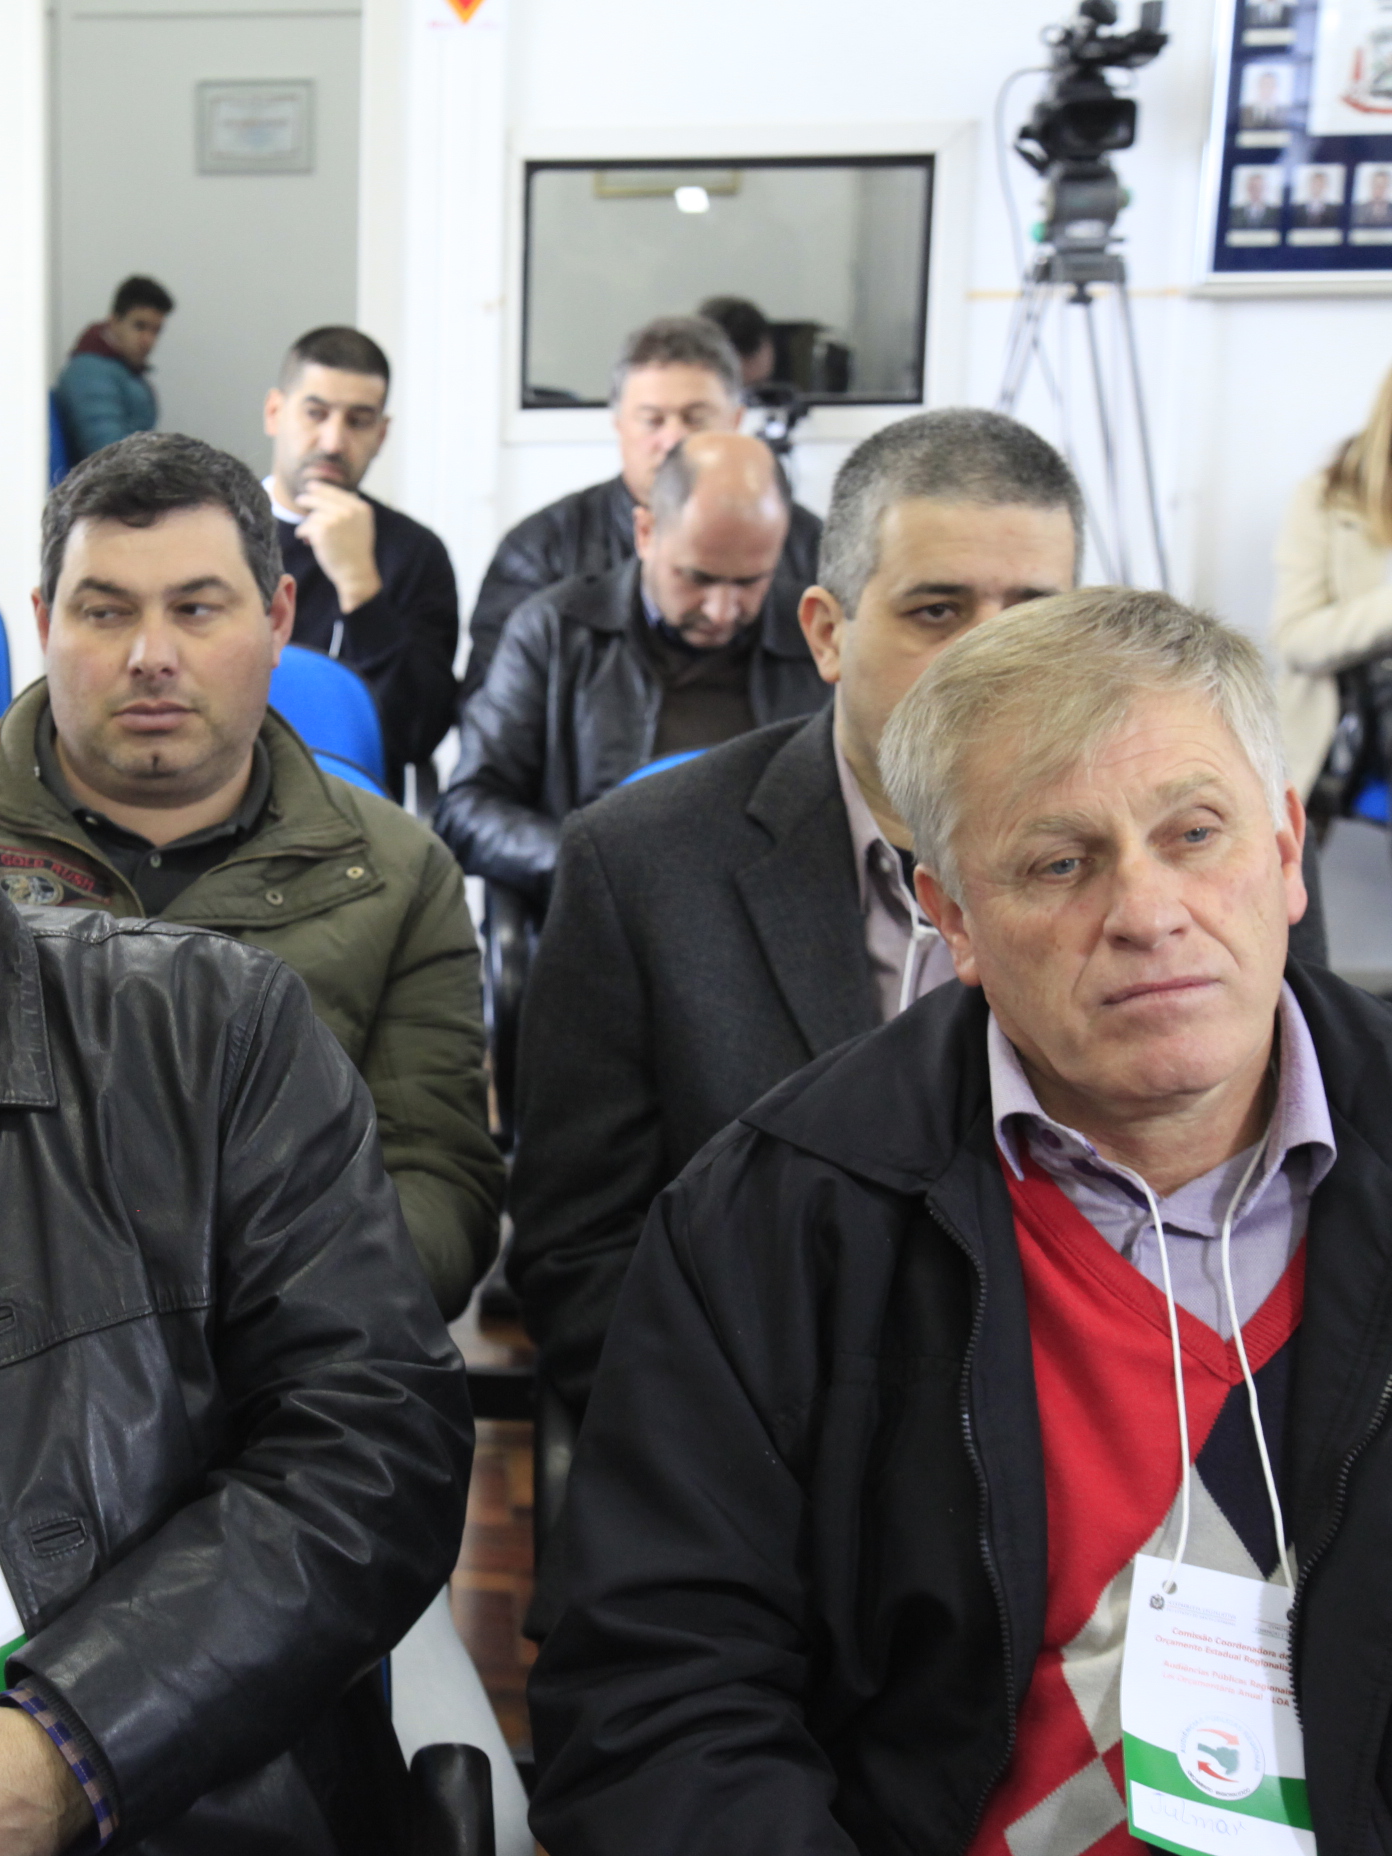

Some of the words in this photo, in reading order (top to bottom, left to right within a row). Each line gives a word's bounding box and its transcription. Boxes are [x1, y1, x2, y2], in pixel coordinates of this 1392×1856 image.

[1, 854, 44, 868] GOLD
[1155, 1634, 1203, 1652] Orçamento
[1205, 1646, 1242, 1661] Estadual
[1172, 1627, 1213, 1643] Comissão
[1215, 1637, 1277, 1658] Coordenadora
[1238, 1688, 1263, 1701] Anual
[1272, 1696, 1290, 1706] LOA
